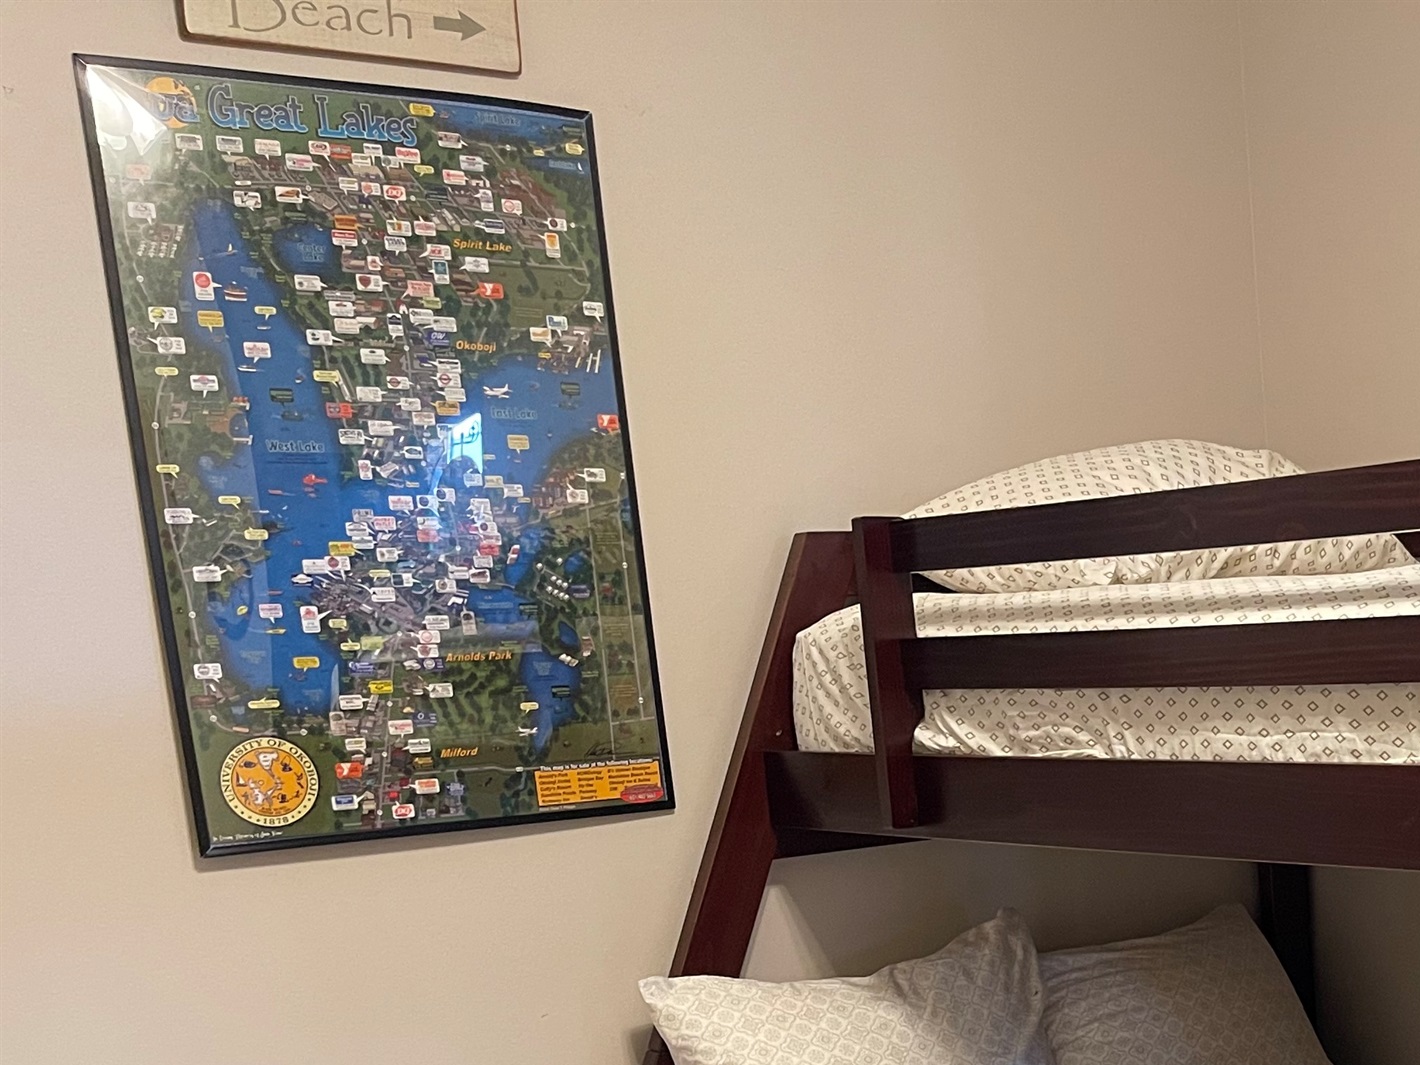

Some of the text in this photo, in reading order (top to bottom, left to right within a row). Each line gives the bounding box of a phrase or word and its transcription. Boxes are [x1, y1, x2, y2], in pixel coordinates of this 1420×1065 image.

[207, 83, 308, 133] Great
[313, 94, 417, 147] Lakes
[453, 238, 512, 252] Spirit Lake
[456, 340, 496, 353] Okoboji
[514, 407, 538, 420] Lake
[266, 439, 326, 453] West Lake
[446, 650, 512, 663] Arnolds Park
[440, 747, 479, 758] Milford
[222, 739, 318, 802] UNIVERSITY OF OKOBOJI
[262, 816, 290, 825] 1878
